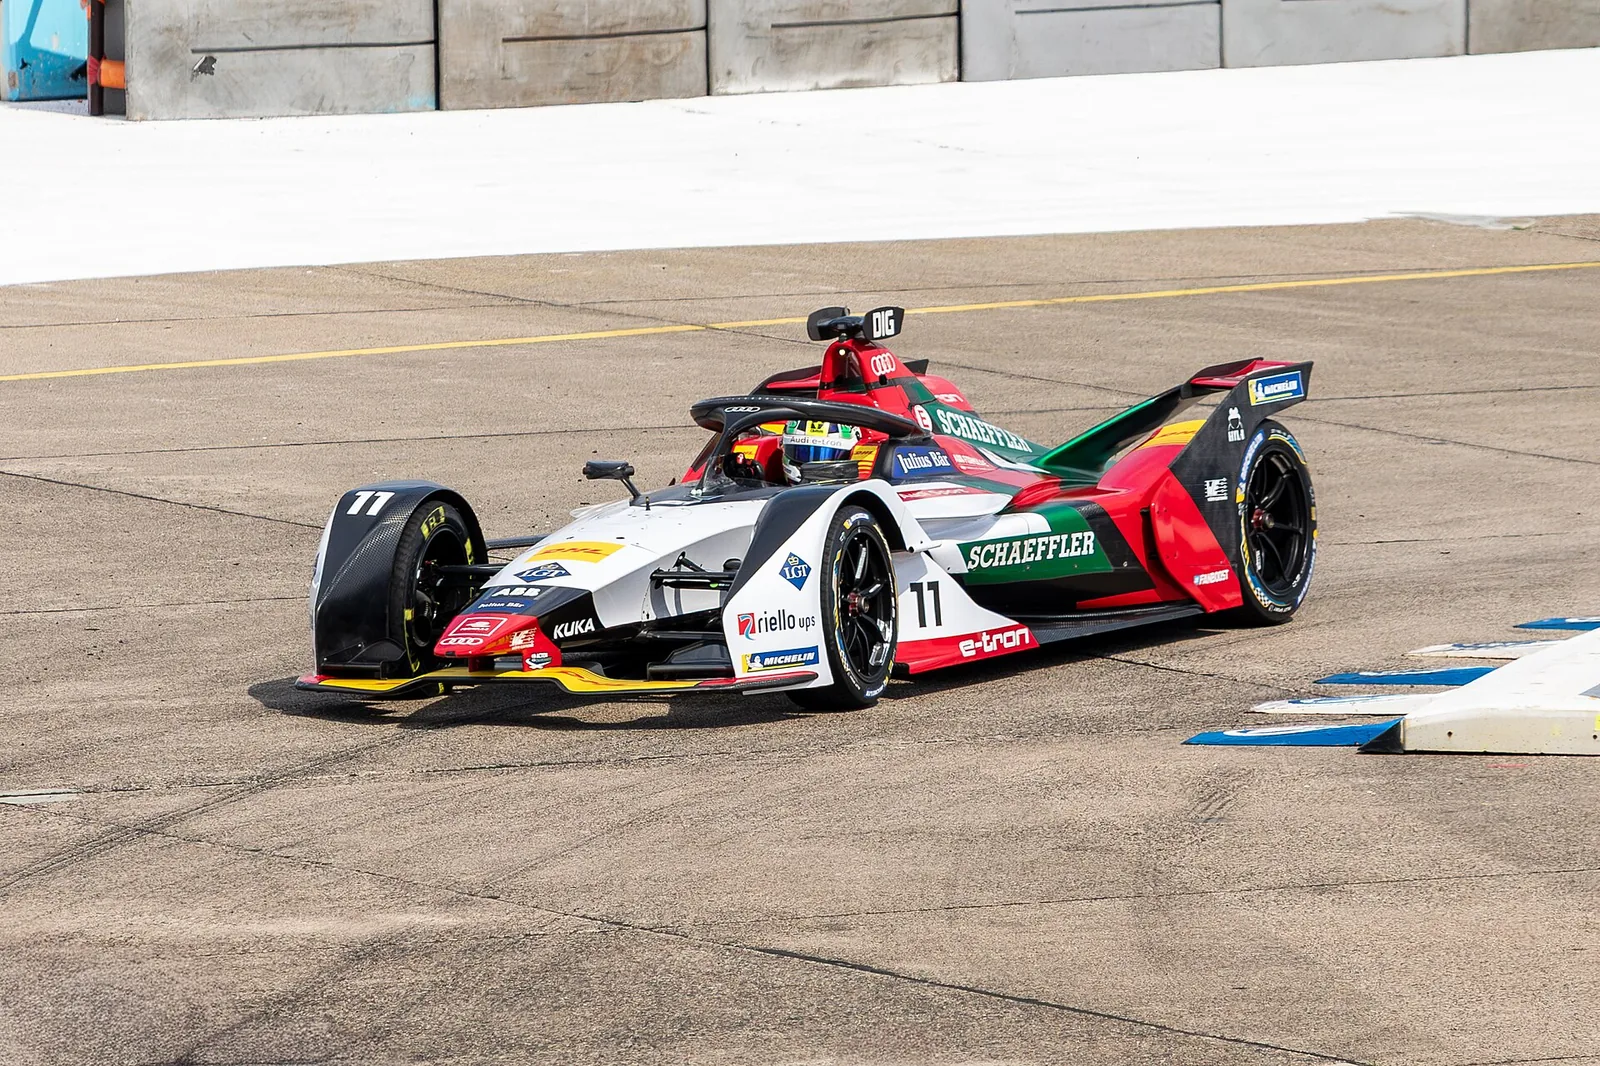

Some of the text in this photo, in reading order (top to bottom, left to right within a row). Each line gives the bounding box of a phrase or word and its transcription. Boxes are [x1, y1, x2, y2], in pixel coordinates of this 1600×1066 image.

[872, 309, 895, 339] DIG
[789, 435, 810, 444] Audi
[936, 409, 1033, 453] SCHAEFFLER
[896, 453, 931, 474] Julius
[930, 451, 951, 468] Bär
[346, 490, 396, 517] 11
[967, 531, 1096, 570] SCHAEFFLER
[519, 570, 567, 578] LGT
[783, 564, 809, 580] LGT
[491, 587, 541, 597] ABB
[909, 580, 943, 628] 11
[553, 617, 596, 640] KUKA
[757, 609, 816, 633] riello ups
[958, 626, 1030, 658] e-tron
[763, 652, 816, 666] MICHELIN
